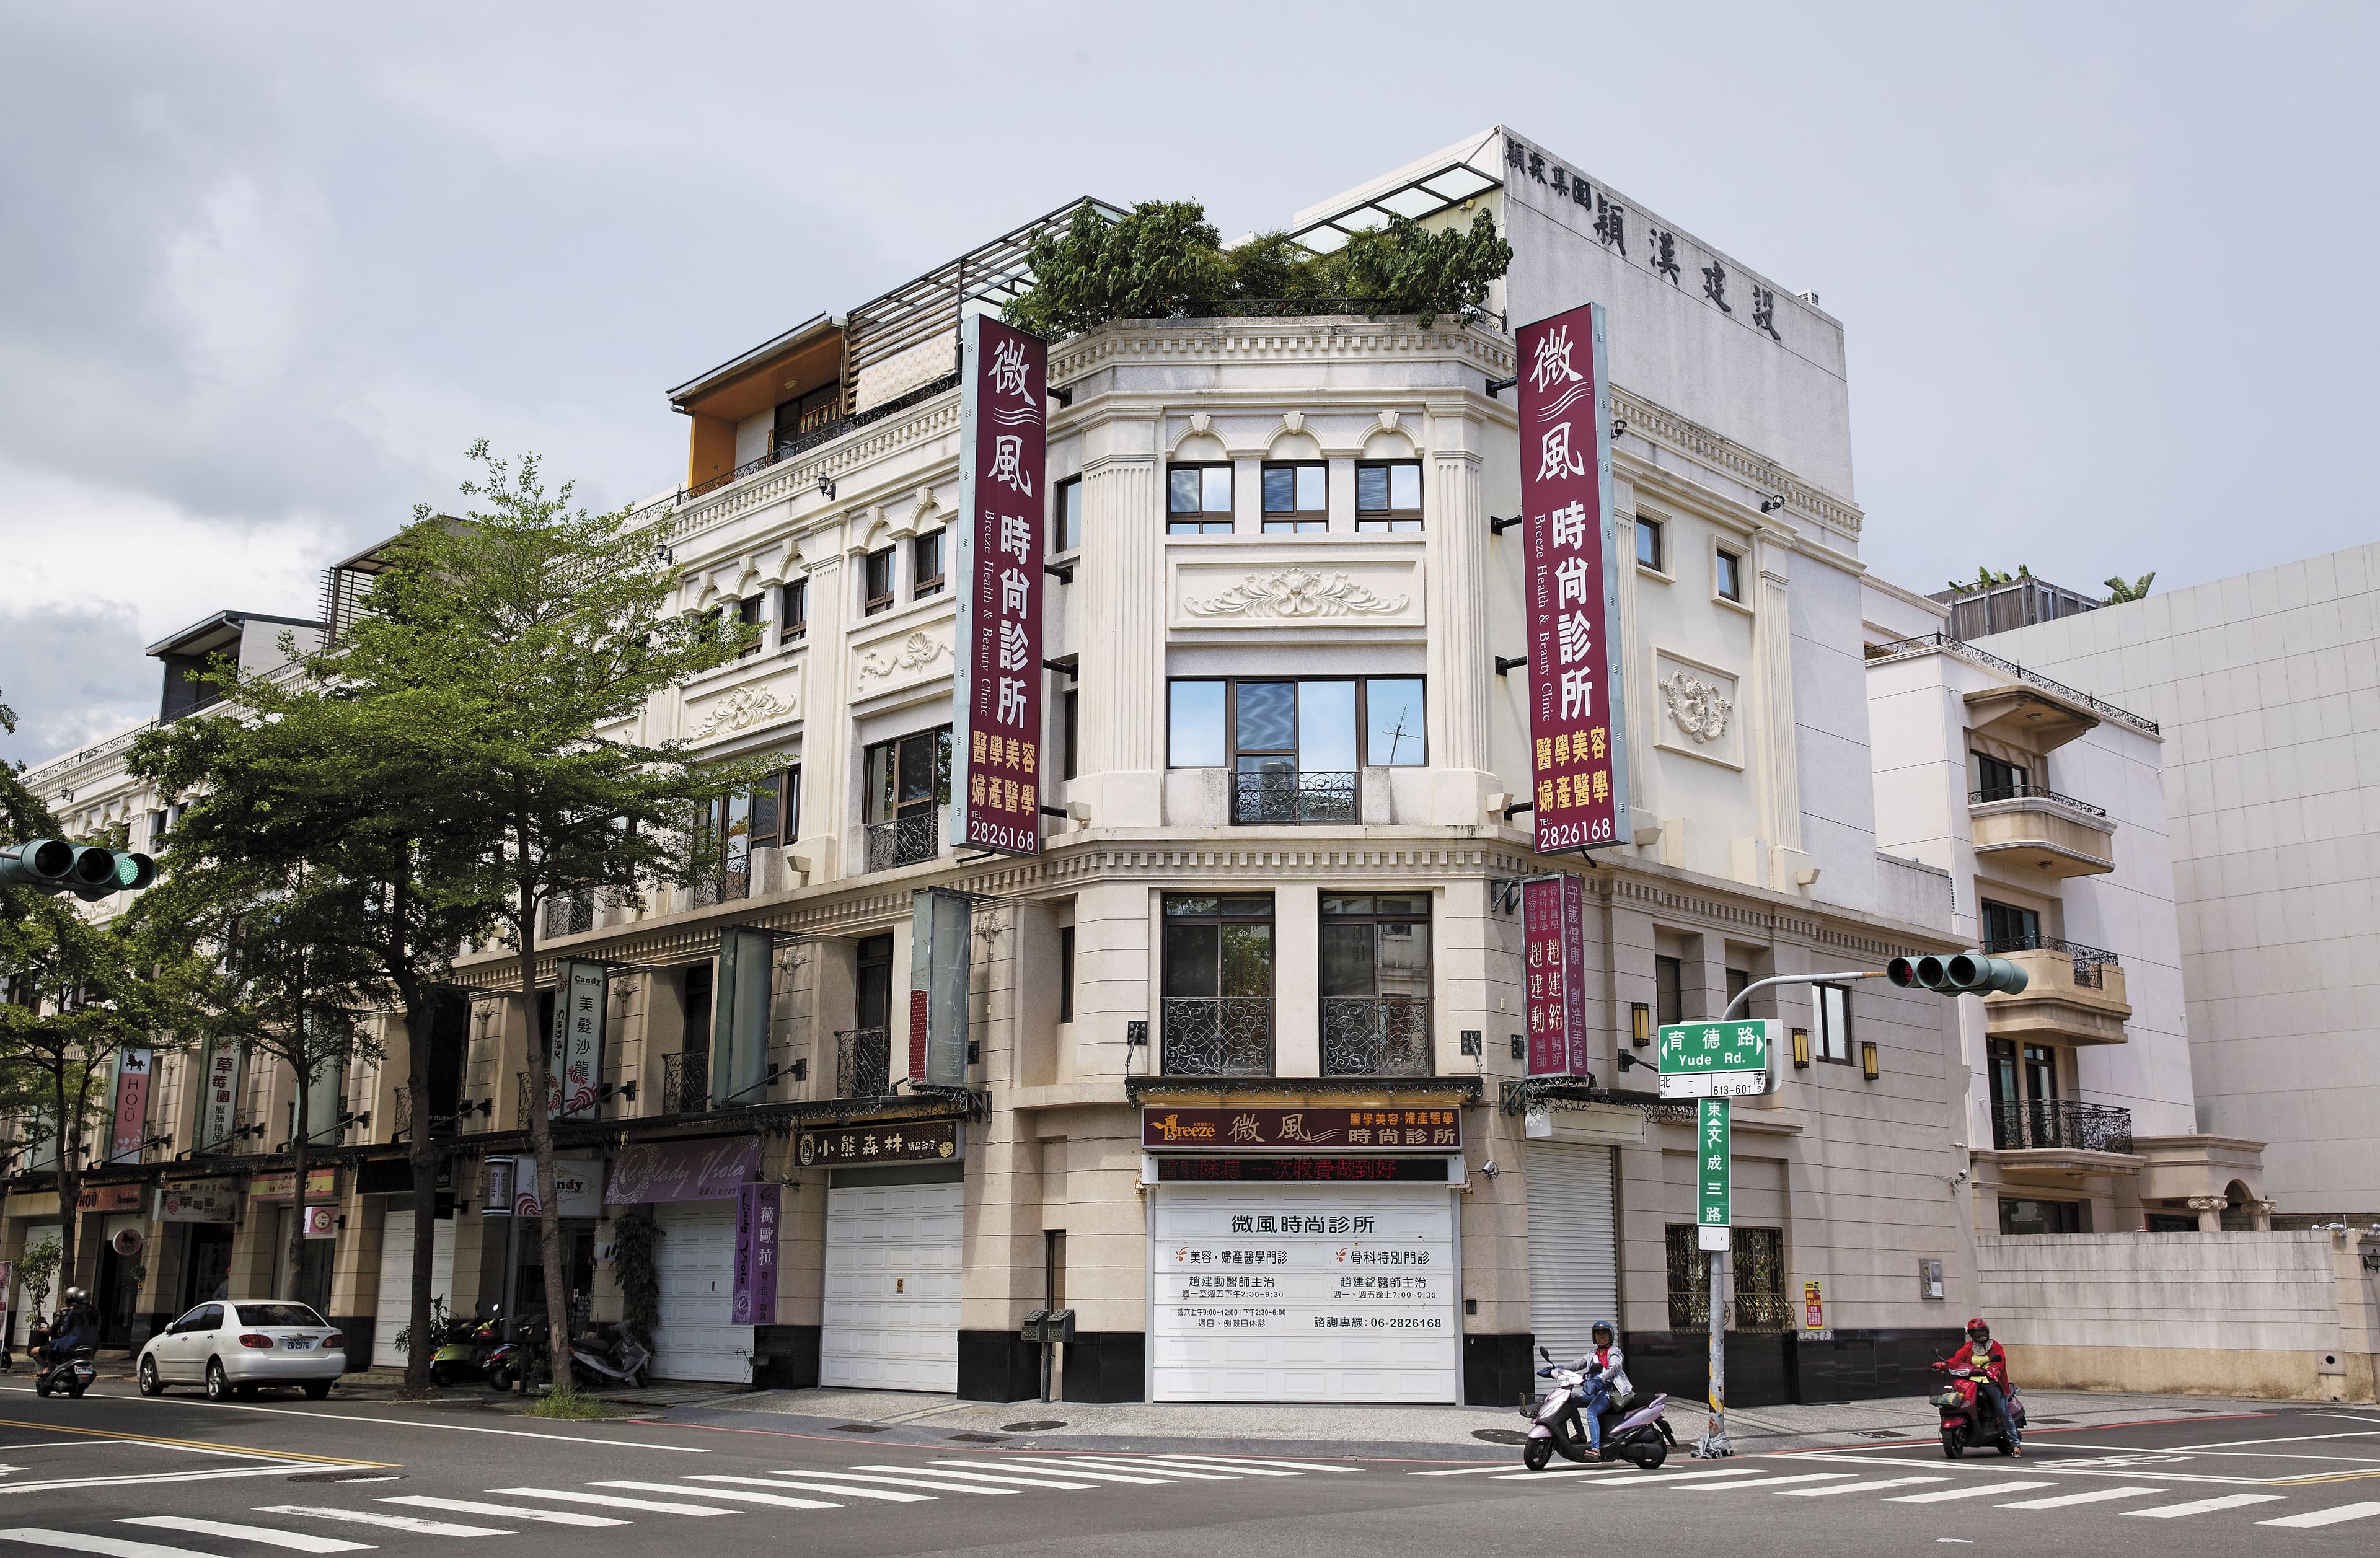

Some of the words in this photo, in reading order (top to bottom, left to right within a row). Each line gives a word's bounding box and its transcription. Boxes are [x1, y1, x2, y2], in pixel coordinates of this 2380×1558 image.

[988, 338, 1036, 498] 微風
[1529, 325, 1585, 483] 微風
[984, 510, 995, 553] Breeze
[1535, 513, 1546, 558] Breeze
[983, 560, 994, 603] Health
[1537, 563, 1548, 609] Health
[982, 609, 993, 619] &
[997, 514, 1031, 729] 時尚診所
[1538, 614, 1549, 625] &
[1552, 500, 1593, 721] 時尚診所
[981, 627, 992, 672] Beauty
[1539, 630, 1550, 676] Beauty
[981, 678, 992, 716] Clinic
[1541, 682, 1553, 722] Clinic
[972, 730, 1036, 774] 醫學美容
[1536, 725, 1606, 772] 醫學美容
[972, 772, 1035, 816] 婦產醫學
[1538, 770, 1608, 814] 婦產醫學
[971, 810, 984, 820] TEL:
[1539, 818, 1553, 826] TEL:
[1540, 817, 1611, 848] 2826168
[971, 820, 1034, 852] 2826168
[574, 975, 601, 986] Candy
[1546, 938, 1562, 1031] 趙建銘
[555, 1009, 565, 1059] Candy
[575, 995, 593, 1081] 美髮沙龍
[1551, 1036, 1562, 1067] 醫師
[1668, 1026, 1755, 1051] 育德路
[1536, 1037, 1547, 1070] 醫師
[1678, 1054, 1712, 1067] Yude
[1724, 1052, 1745, 1065] Rd.
[212, 1057, 234, 1102] 草莓園
[1660, 1076, 1671, 1088] 北
[1713, 1085, 1752, 1096] 613-601
[1753, 1072, 1765, 1085] 南
[125, 1078, 139, 1122] HOÜ
[213, 1104, 226, 1142] 服飾精品
[1163, 1125, 1215, 1141] Breeze
[1228, 1113, 1311, 1142] 微風
[1348, 1128, 1456, 1145] 時尚診所
[818, 1133, 902, 1157] 小熊森林
[179, 1196, 214, 1210] 草莓園
[556, 1179, 583, 1192] ndy
[759, 1206, 774, 1265] 薇歐拉
[1231, 1214, 1375, 1233] 微風時尚診所
[1351, 1251, 1430, 1265] 骨科特別門診
[1340, 1277, 1427, 1288] 趙建銘醫師主治
